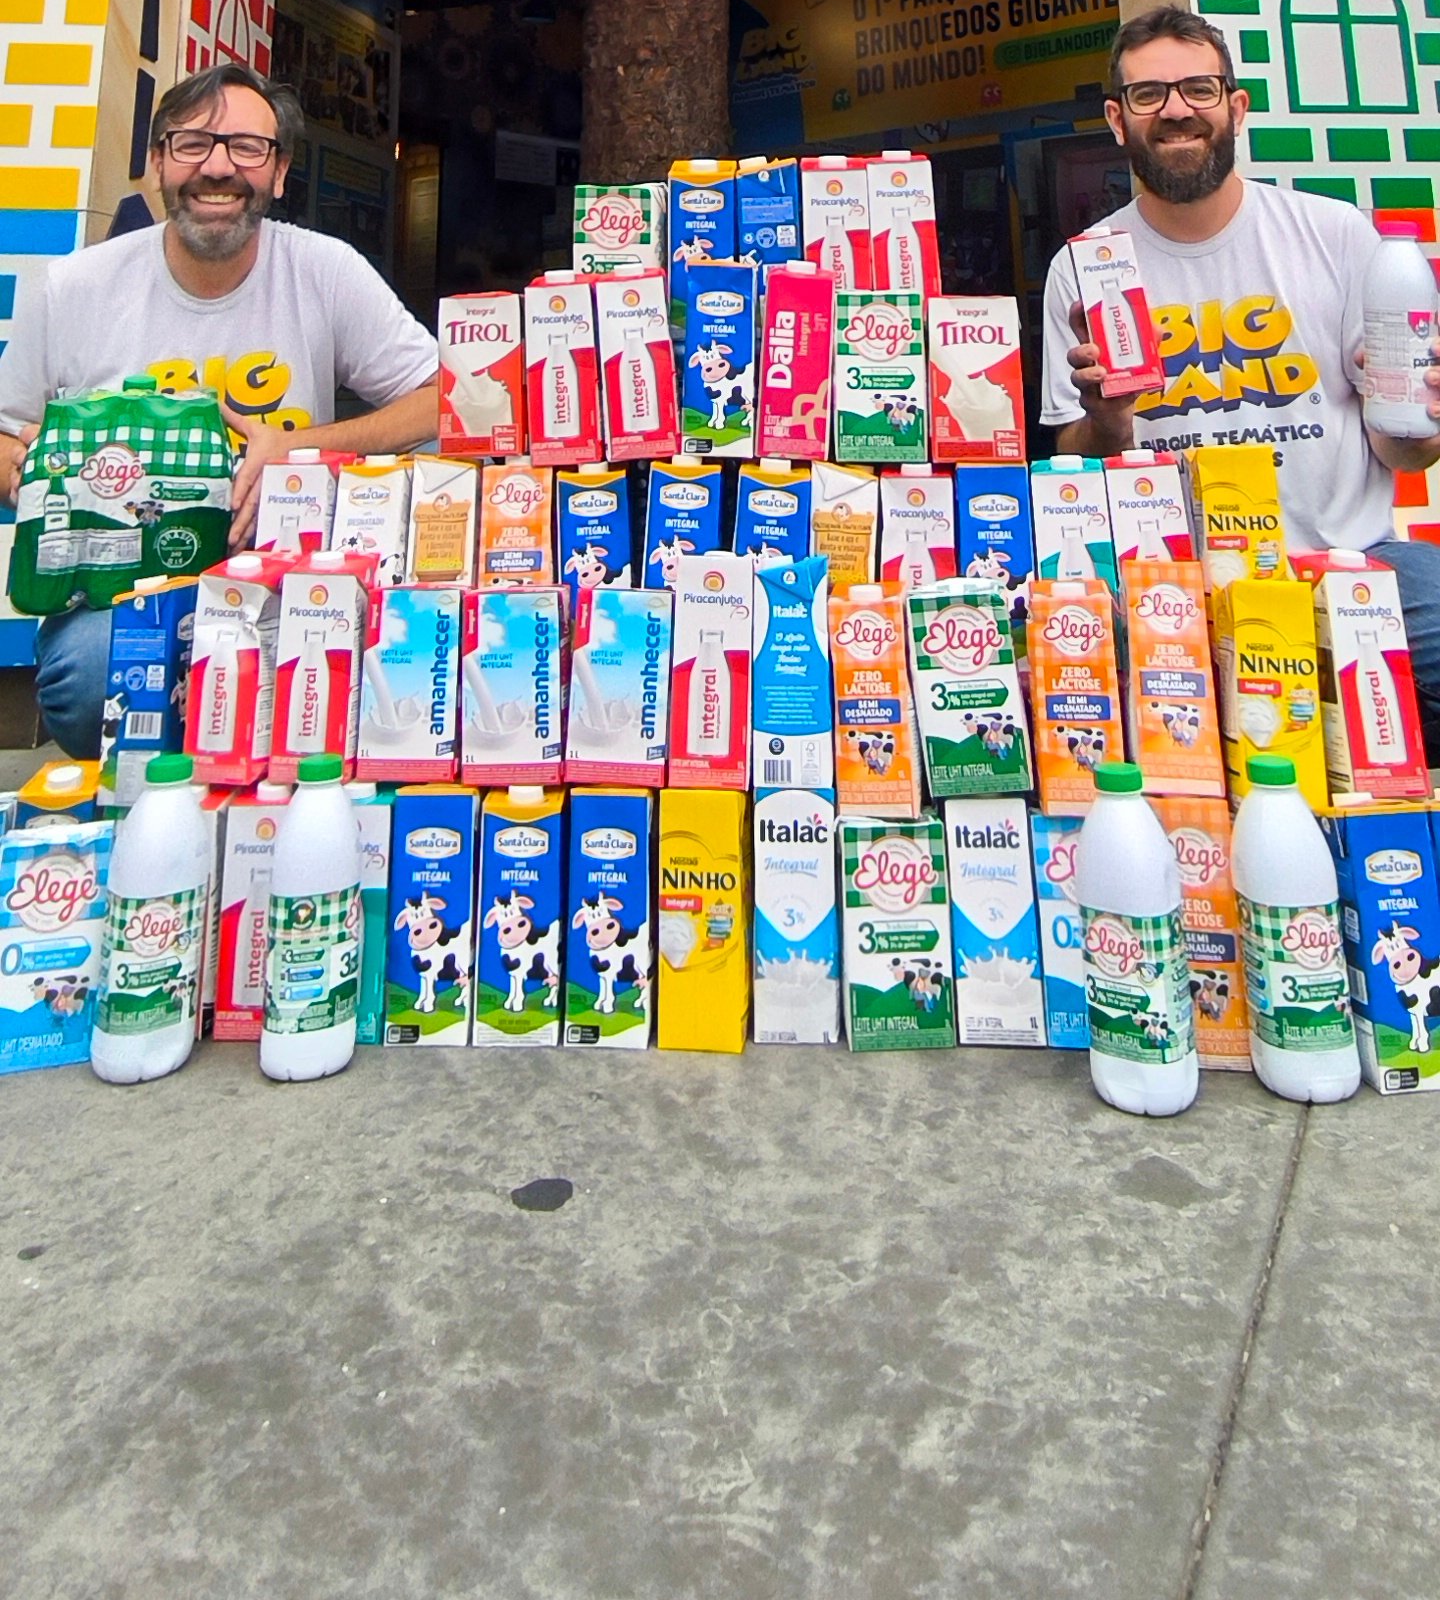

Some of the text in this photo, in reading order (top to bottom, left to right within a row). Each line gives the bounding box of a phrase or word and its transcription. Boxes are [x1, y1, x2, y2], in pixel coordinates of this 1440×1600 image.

[855, 1, 1001, 60] BRINQUEDOS
[855, 44, 986, 98] DO MUNDO!
[876, 190, 924, 198] Piracanjuba
[811, 198, 860, 208] Piracanjuba
[896, 236, 912, 289] integral
[699, 300, 741, 308] Santa Clara
[606, 307, 658, 318] Piracanjuba
[532, 314, 584, 324] Piracanjuba
[703, 325, 736, 334] INTEGRAL
[1109, 305, 1129, 357] integral
[1150, 295, 1293, 358] BIG
[446, 321, 514, 346] TIROL
[937, 321, 1012, 347] TIROL
[766, 311, 796, 389] Dália
[145, 350, 292, 408] BIG
[554, 365, 569, 424] integral
[632, 359, 646, 418] integral
[1212, 423, 1324, 447] TEMÁTICO
[268, 495, 317, 505] Piracanjuba
[351, 491, 389, 499] Santa Clara
[663, 492, 706, 501] Santa Clara
[571, 499, 614, 508] Santa Clara
[752, 498, 795, 508] Santa Clara
[972, 503, 1016, 512] Santa Clara
[1118, 498, 1174, 509] Piracanjuba
[890, 509, 944, 518] Piracanjuba
[1043, 505, 1098, 515] Piracanjuba
[665, 519, 699, 529] INTEGRAL
[1208, 514, 1278, 531] NINHO
[501, 527, 528, 537] ZERO
[576, 526, 611, 535] INTEGRAL
[753, 525, 788, 536] INTEGRAL
[978, 530, 1013, 540] INTEGRAL
[493, 537, 536, 547] LACTOSE
[684, 594, 743, 605] Piracanjuba
[289, 608, 344, 619] Piracanjuba
[773, 602, 808, 619] Italac
[1337, 606, 1392, 618] Piracanjuba
[1154, 644, 1185, 656] ZERO
[1145, 655, 1195, 668] LACTOSE
[1240, 653, 1315, 675] NINHO
[430, 609, 450, 735] amanhecer
[532, 612, 549, 739] amanhecer
[641, 612, 661, 740] amanhecer
[853, 671, 882, 682] ZERO
[1060, 667, 1091, 677] ZERO
[1160, 672, 1182, 681] SEMI
[844, 682, 892, 694] LACTOSE
[1052, 678, 1101, 690] LACTOSE
[208, 667, 227, 735] integral
[299, 668, 318, 737] integral
[700, 668, 719, 739] integral
[858, 700, 878, 709] SEMI
[1066, 696, 1088, 704] SEMI
[1365, 671, 1391, 745] integral
[760, 819, 828, 843] Italac
[956, 824, 1020, 849] Italac
[410, 838, 458, 848] Santa Clara
[498, 837, 546, 847] Santa Clara
[585, 838, 633, 849] Santa Clara
[765, 857, 818, 871] Integral
[1175, 837, 1227, 882] legê
[960, 863, 1017, 878] Integral
[1369, 861, 1419, 873] Santa Clara
[412, 871, 450, 882] INTEGRAL
[501, 870, 538, 881] INTEGRAL
[588, 871, 628, 883] INTEGRAL
[662, 868, 736, 891] NINHO
[1378, 898, 1419, 911] INTEGRAL
[245, 911, 265, 988] integral
